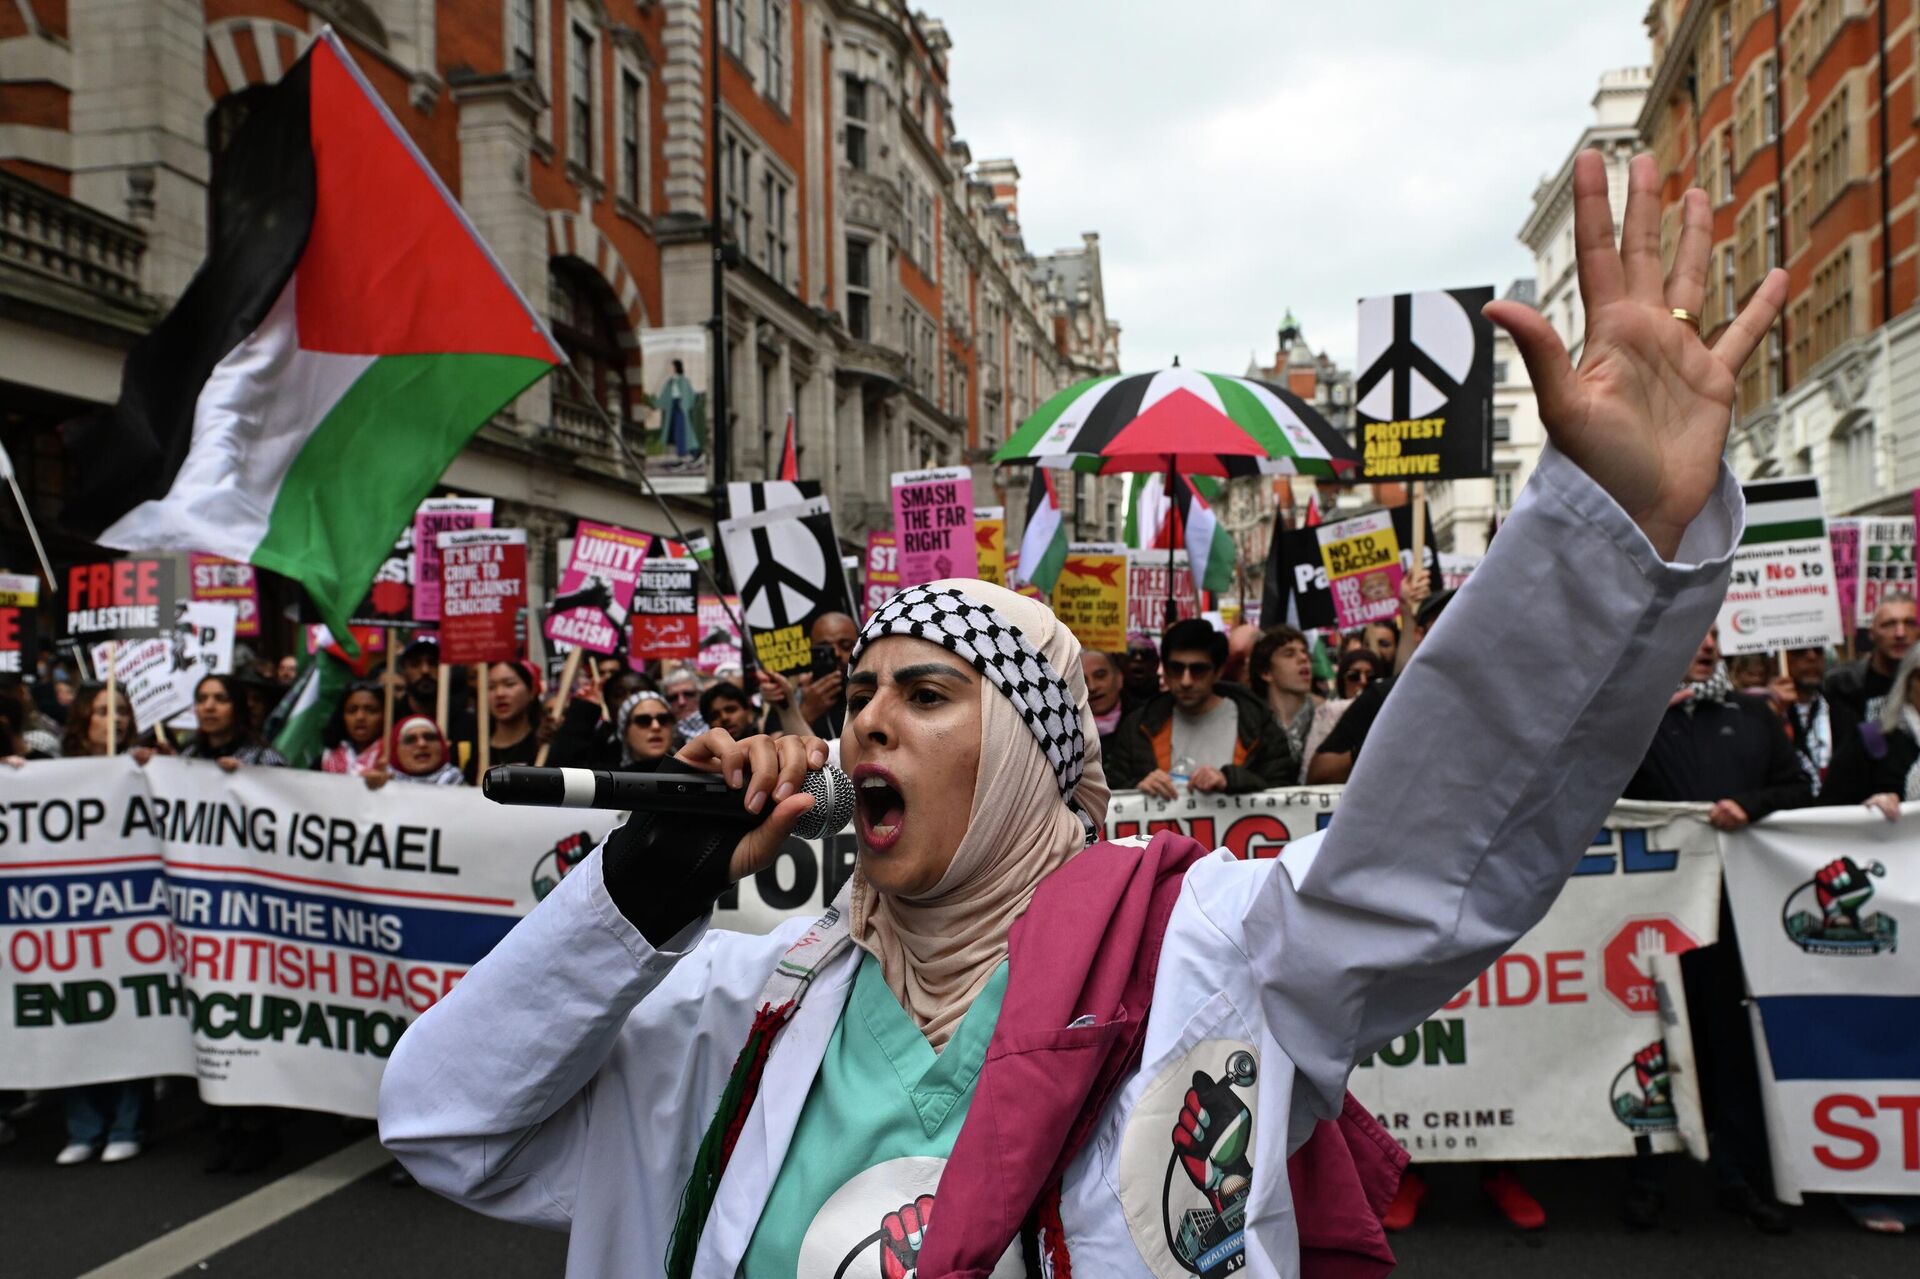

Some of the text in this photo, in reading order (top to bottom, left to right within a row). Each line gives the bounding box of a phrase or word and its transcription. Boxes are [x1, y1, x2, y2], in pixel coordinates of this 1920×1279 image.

[1364, 418, 1445, 442] PROTEST
[1363, 439, 1402, 459] AND
[1363, 454, 1440, 477] SURVIVE
[901, 484, 957, 509] SMASH
[902, 505, 966, 530] THE FAR
[577, 535, 644, 571] UNITY
[904, 529, 951, 553] RIGHT
[1328, 537, 1375, 560] NO TO
[467, 546, 491, 563] NOT
[494, 545, 504, 562] A
[1332, 548, 1392, 576] RACISM
[444, 564, 479, 582] CRIME
[482, 562, 500, 579] TO
[636, 573, 691, 590] FREEDOM
[1766, 562, 1796, 581] No
[1802, 561, 1824, 577] to
[68, 560, 160, 612] FREE
[445, 579, 520, 599] ACT AGAINST
[1060, 584, 1101, 598] Together
[1336, 576, 1360, 593] NO
[634, 596, 696, 613] PALESTINE
[1077, 601, 1093, 610] can
[1098, 600, 1119, 612] stop
[1341, 592, 1361, 608] TO
[1343, 597, 1400, 625] TRUMP
[67, 603, 159, 635] PALESTINE
[551, 614, 614, 648] RACISM
[1079, 613, 1093, 623] far
[1097, 613, 1120, 627] right
[757, 636, 812, 661] NUCLEA
[763, 649, 812, 673] WEAPO
[121, 794, 278, 854] ARMING
[287, 811, 460, 876] ISRAEL
[7, 877, 404, 952] NO PALATIR IN THE NHS
[9, 925, 113, 974] OUT
[13, 979, 117, 1028] END
[119, 972, 188, 1018] TH
[1376, 1108, 1515, 1130] AR CRIME
